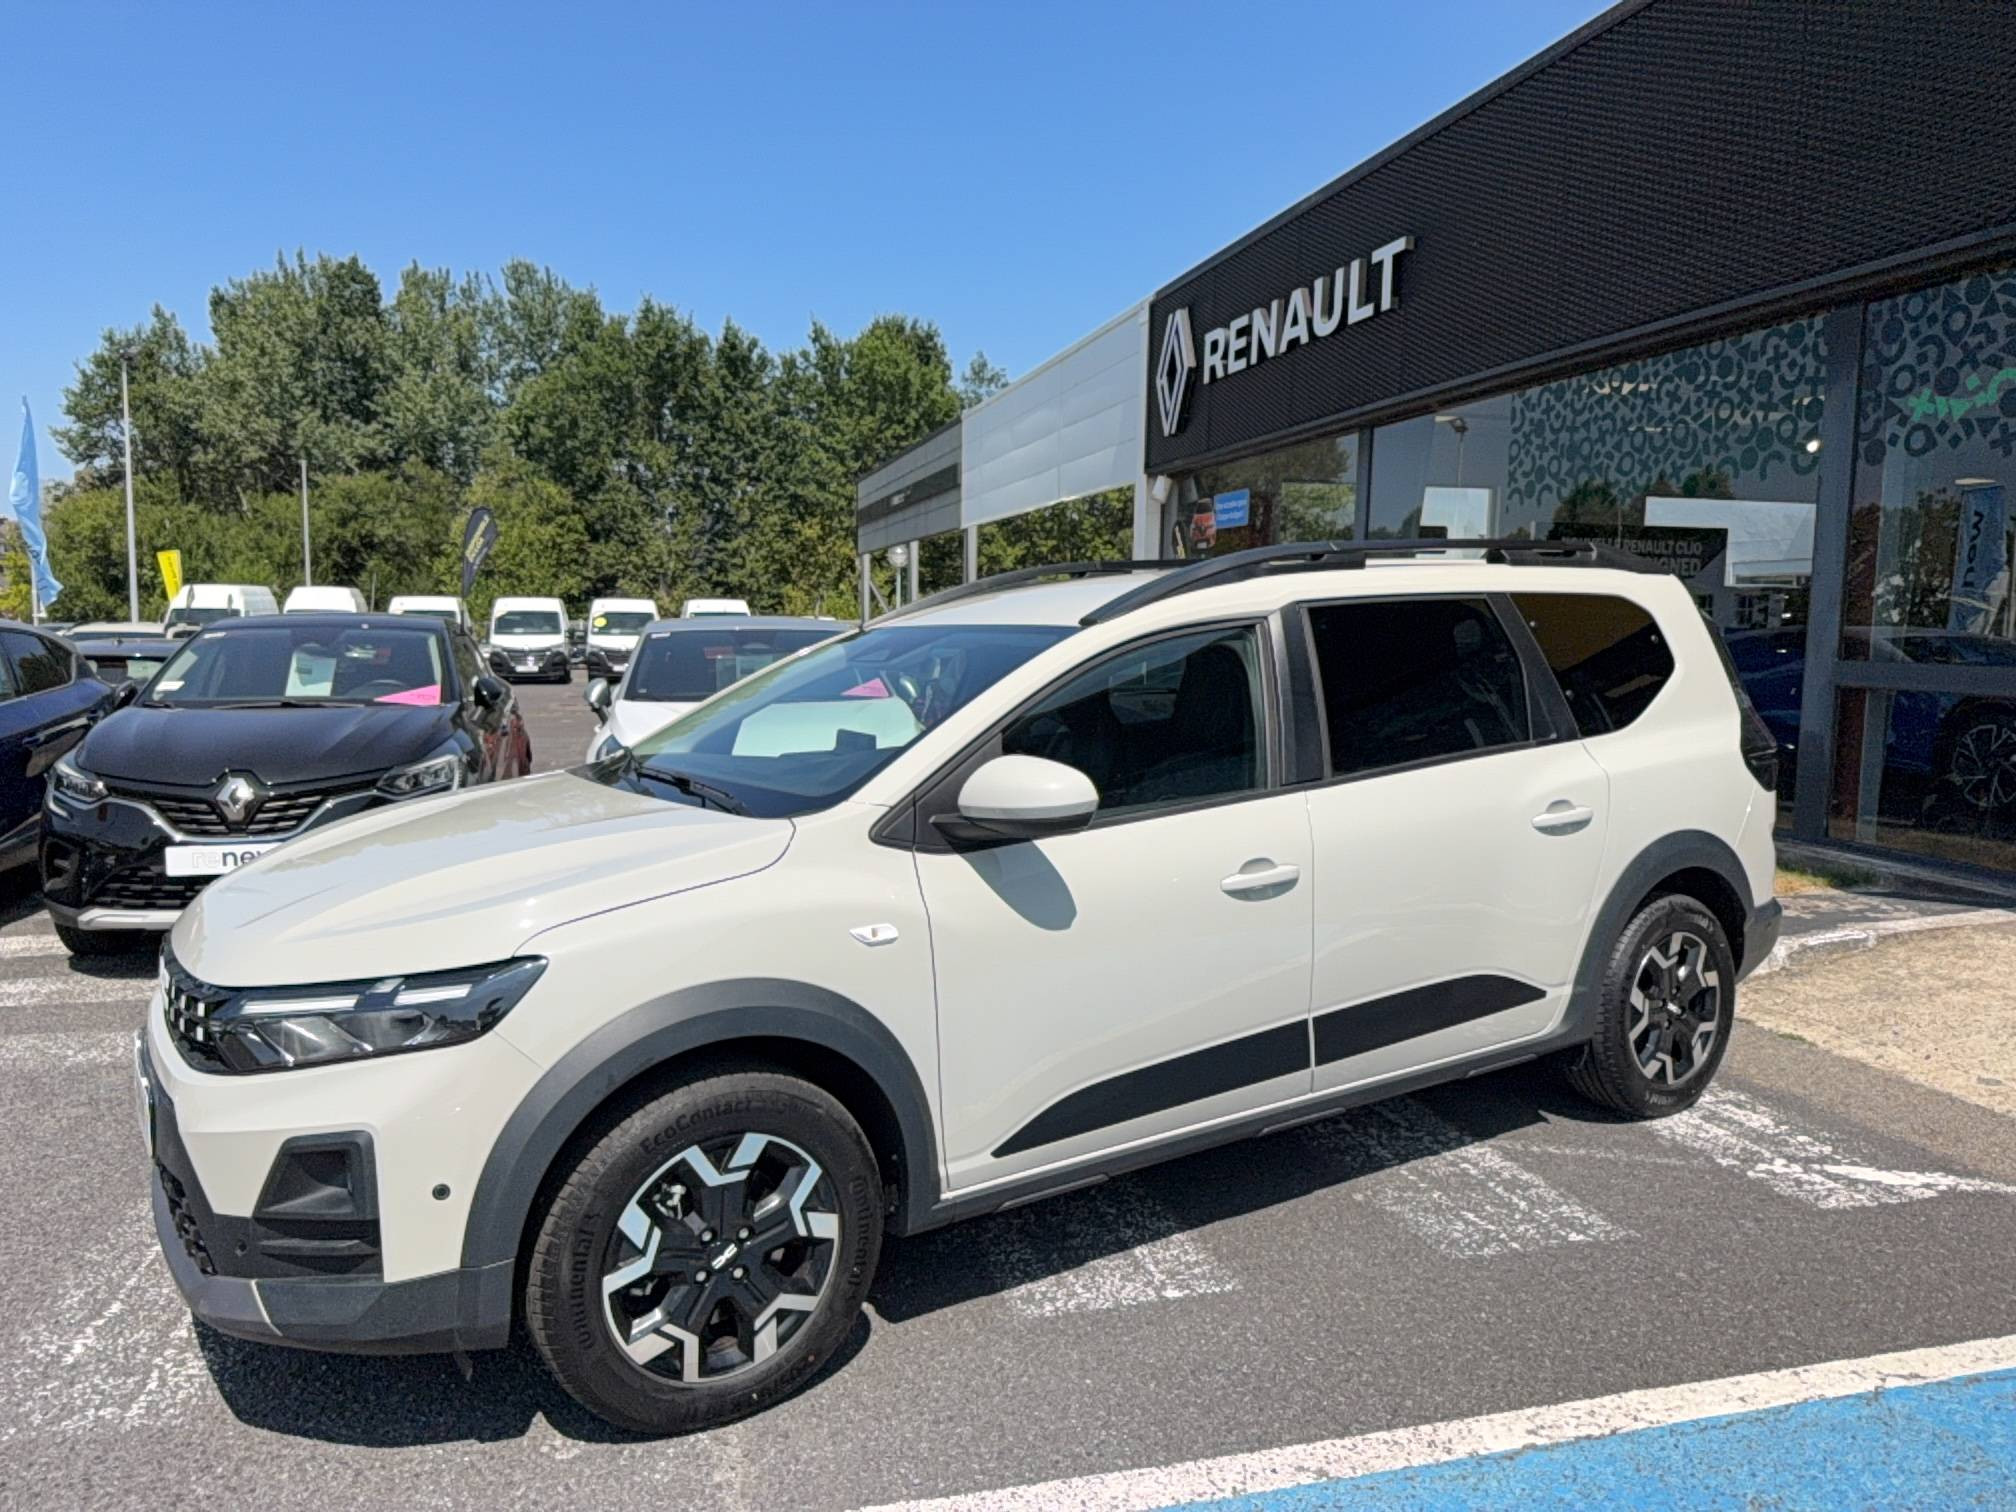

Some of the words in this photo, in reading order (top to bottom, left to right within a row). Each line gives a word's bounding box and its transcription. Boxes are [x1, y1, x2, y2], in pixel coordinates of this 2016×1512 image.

[1203, 236, 1413, 384] RENAULT
[1624, 539, 1675, 555] RENAULT
[1675, 541, 1703, 555] CLIO
